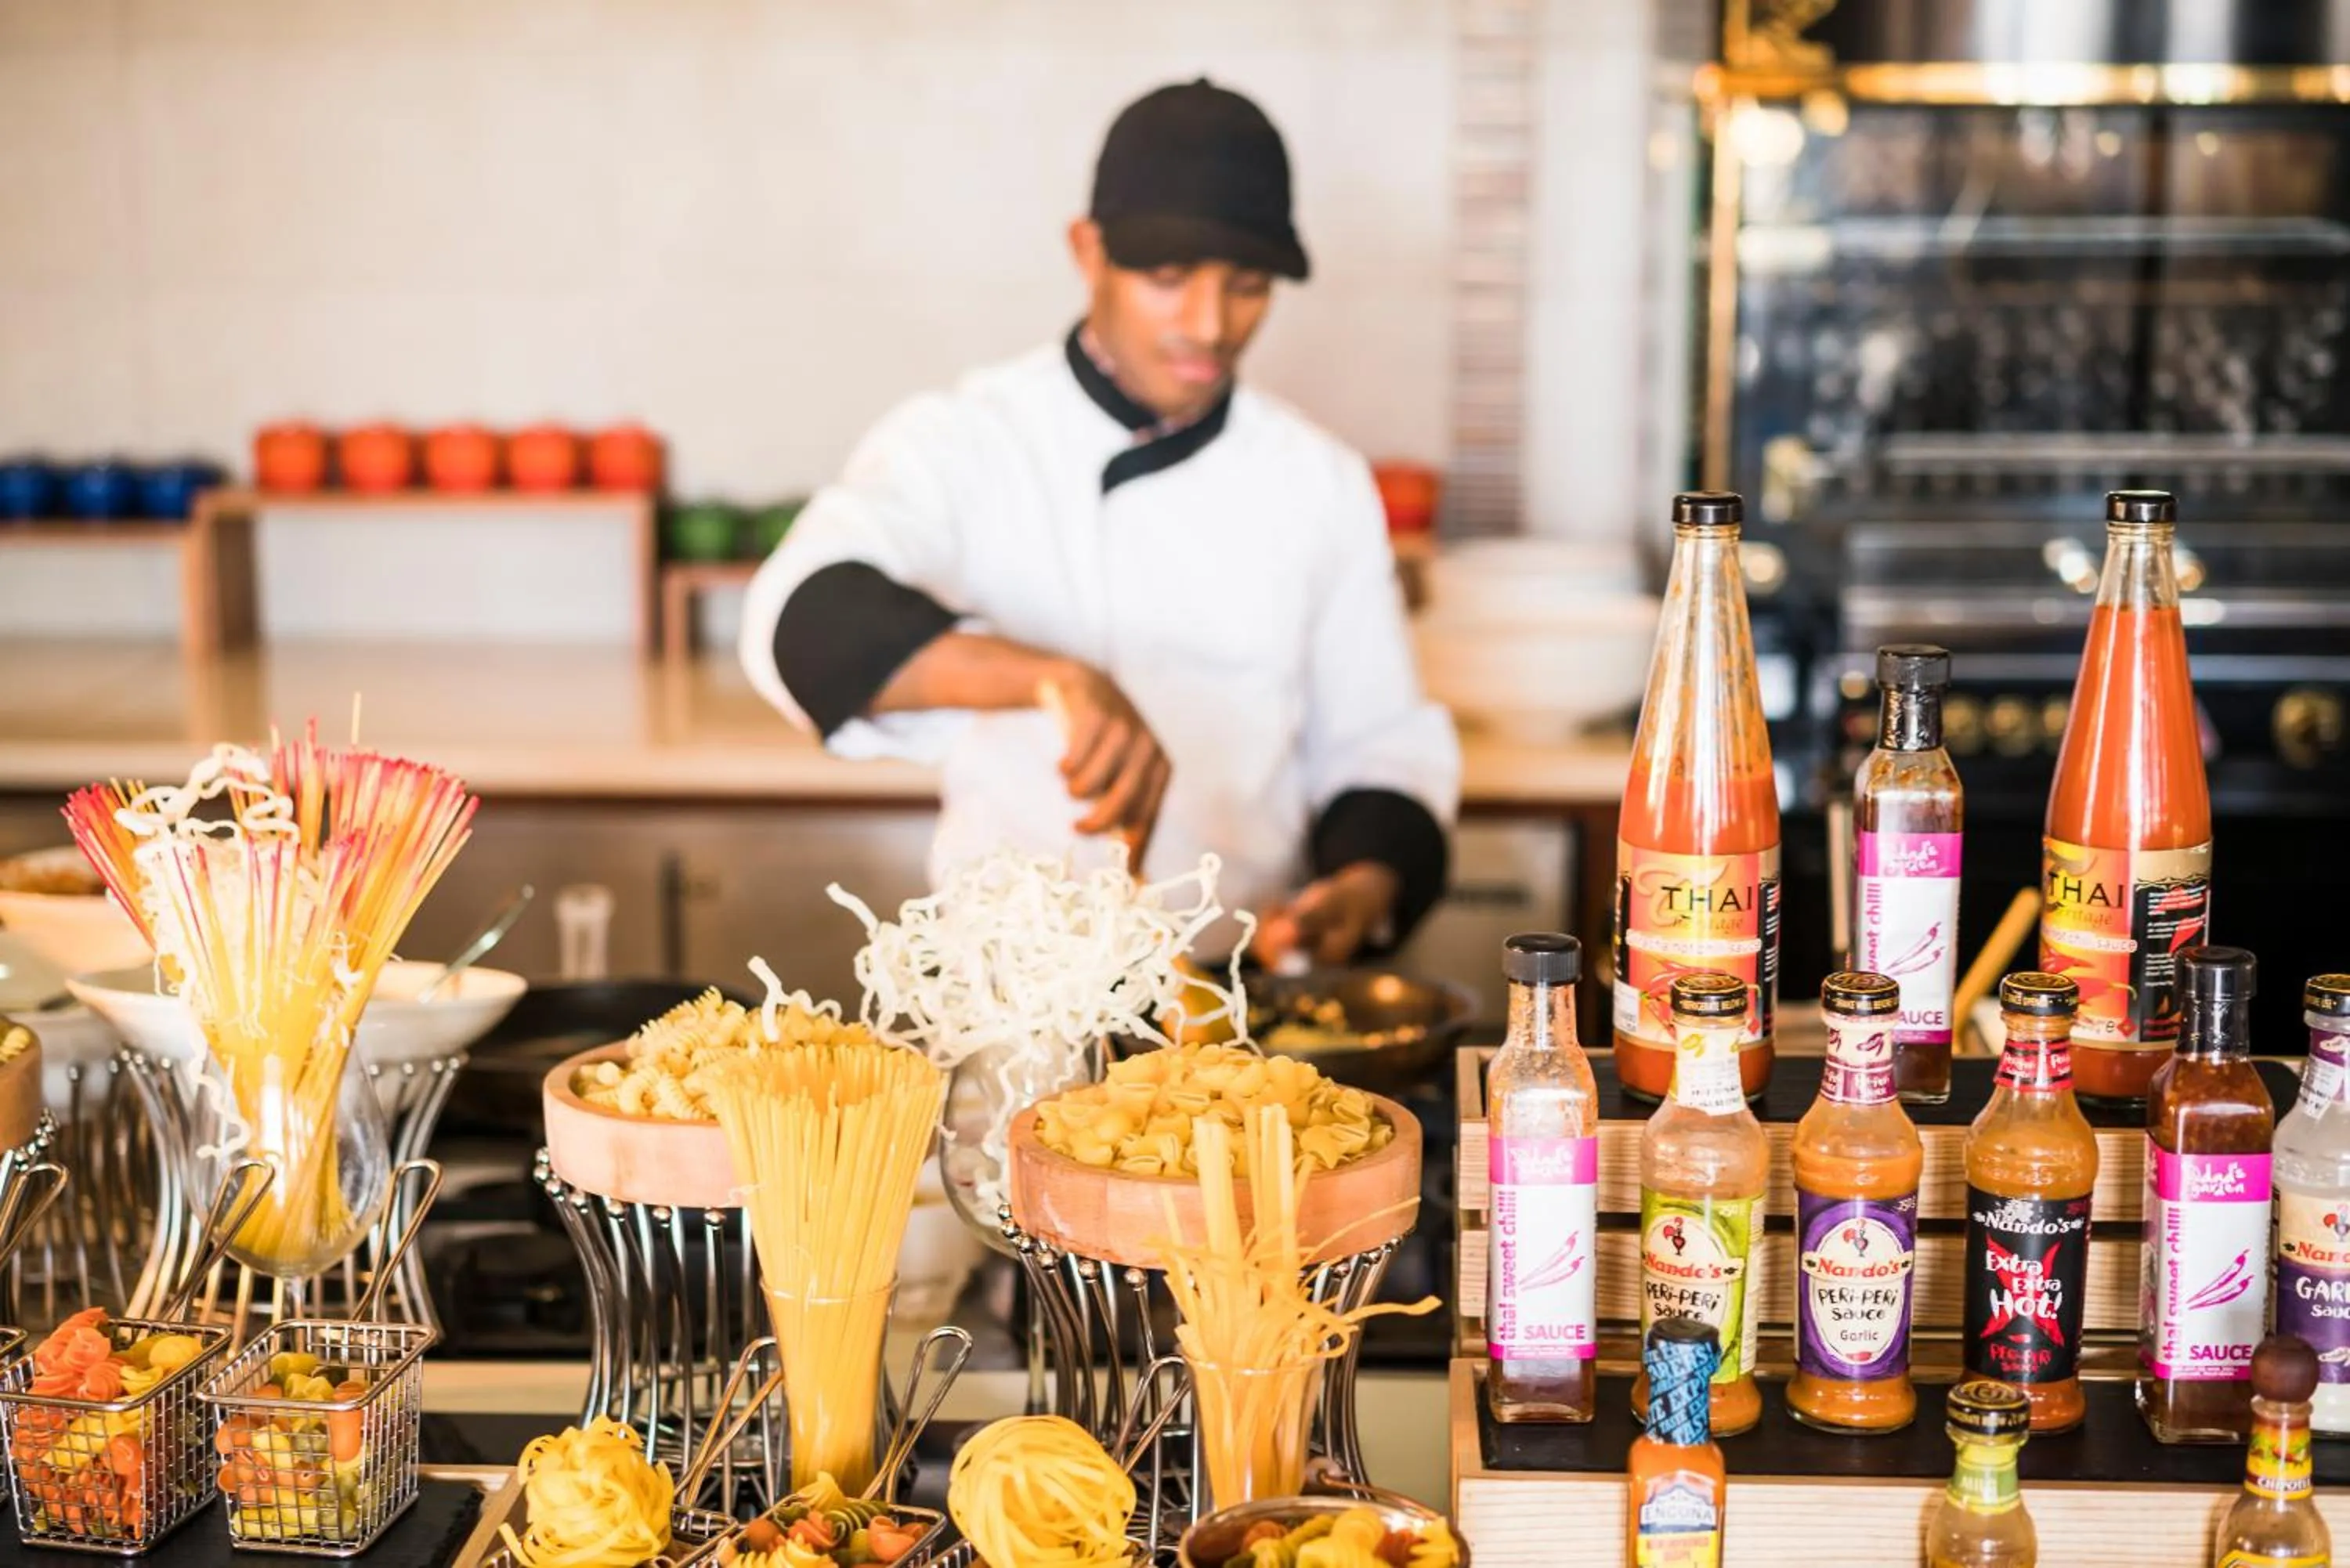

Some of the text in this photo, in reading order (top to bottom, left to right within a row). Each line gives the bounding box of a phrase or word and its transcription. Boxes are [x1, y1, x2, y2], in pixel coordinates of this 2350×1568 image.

[1661, 885, 1752, 912] THAI
[2048, 872, 2124, 908] THAI
[1867, 930, 1879, 972] weet
[1900, 1010, 1943, 1024] AUCE
[1984, 1212, 2071, 1235] Nando's
[1645, 1252, 1722, 1278] Nando's
[1817, 1256, 1901, 1278] Nando's
[1986, 1251, 2044, 1276] Extra
[2012, 1277, 2062, 1295] Extra
[1989, 1288, 2063, 1321] Hot!
[1524, 1324, 1586, 1341] SAUCE
[1840, 1329, 1879, 1341] Garlic
[2189, 1346, 2252, 1360] SAUCE
